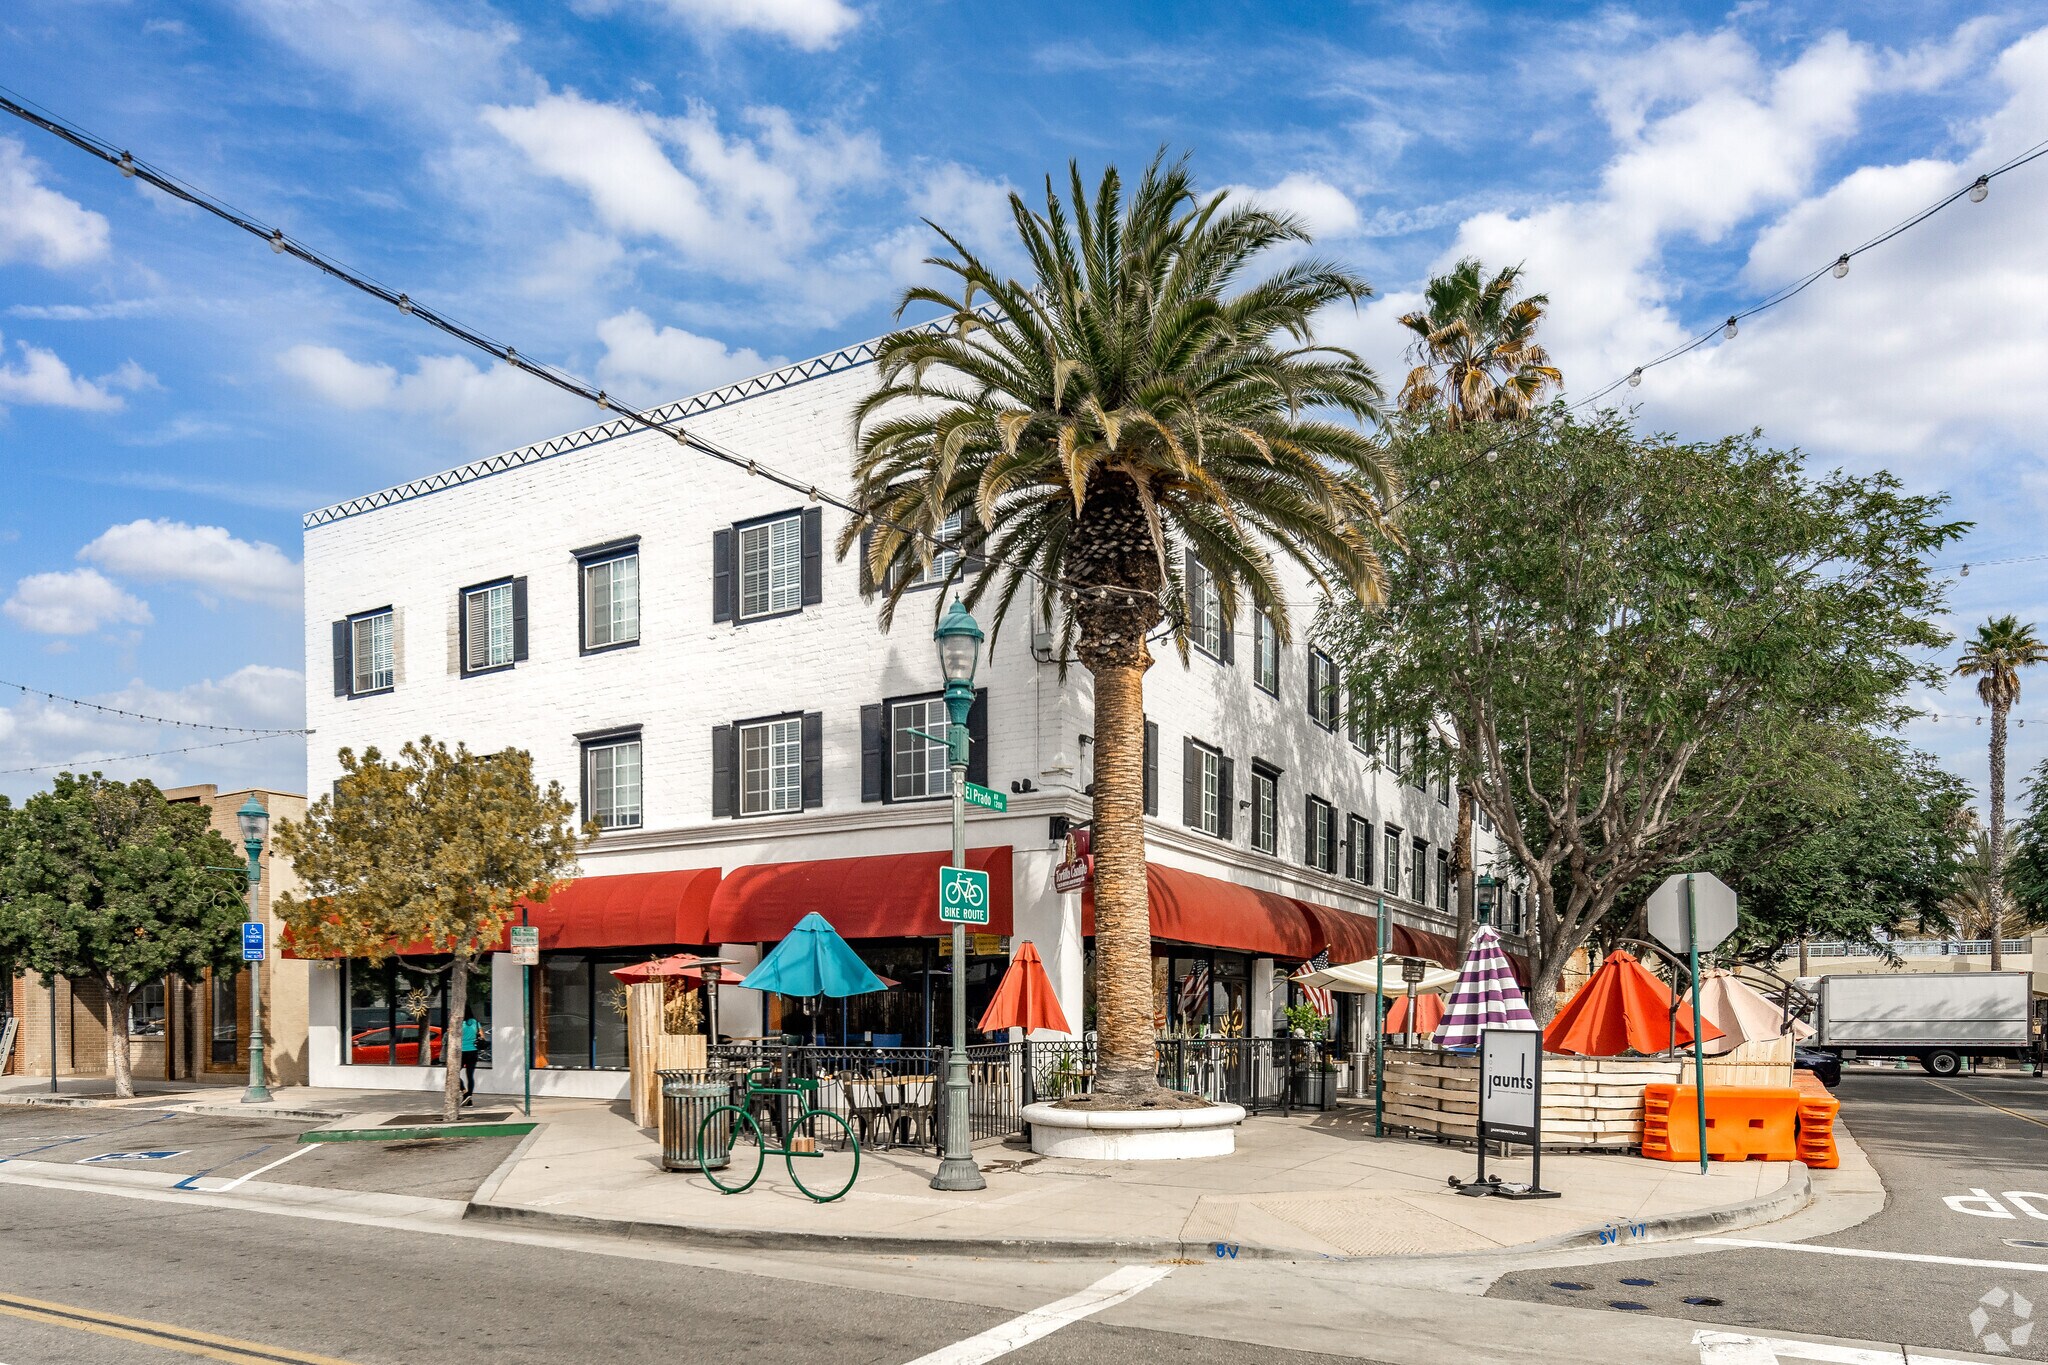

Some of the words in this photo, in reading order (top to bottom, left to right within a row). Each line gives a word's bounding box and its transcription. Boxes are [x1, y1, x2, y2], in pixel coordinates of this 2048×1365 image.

[965, 785, 972, 800] El
[973, 788, 991, 806] Prado
[944, 906, 960, 918] BIKE
[963, 908, 985, 920] ROUTE
[1487, 1052, 1533, 1100] jaunts
